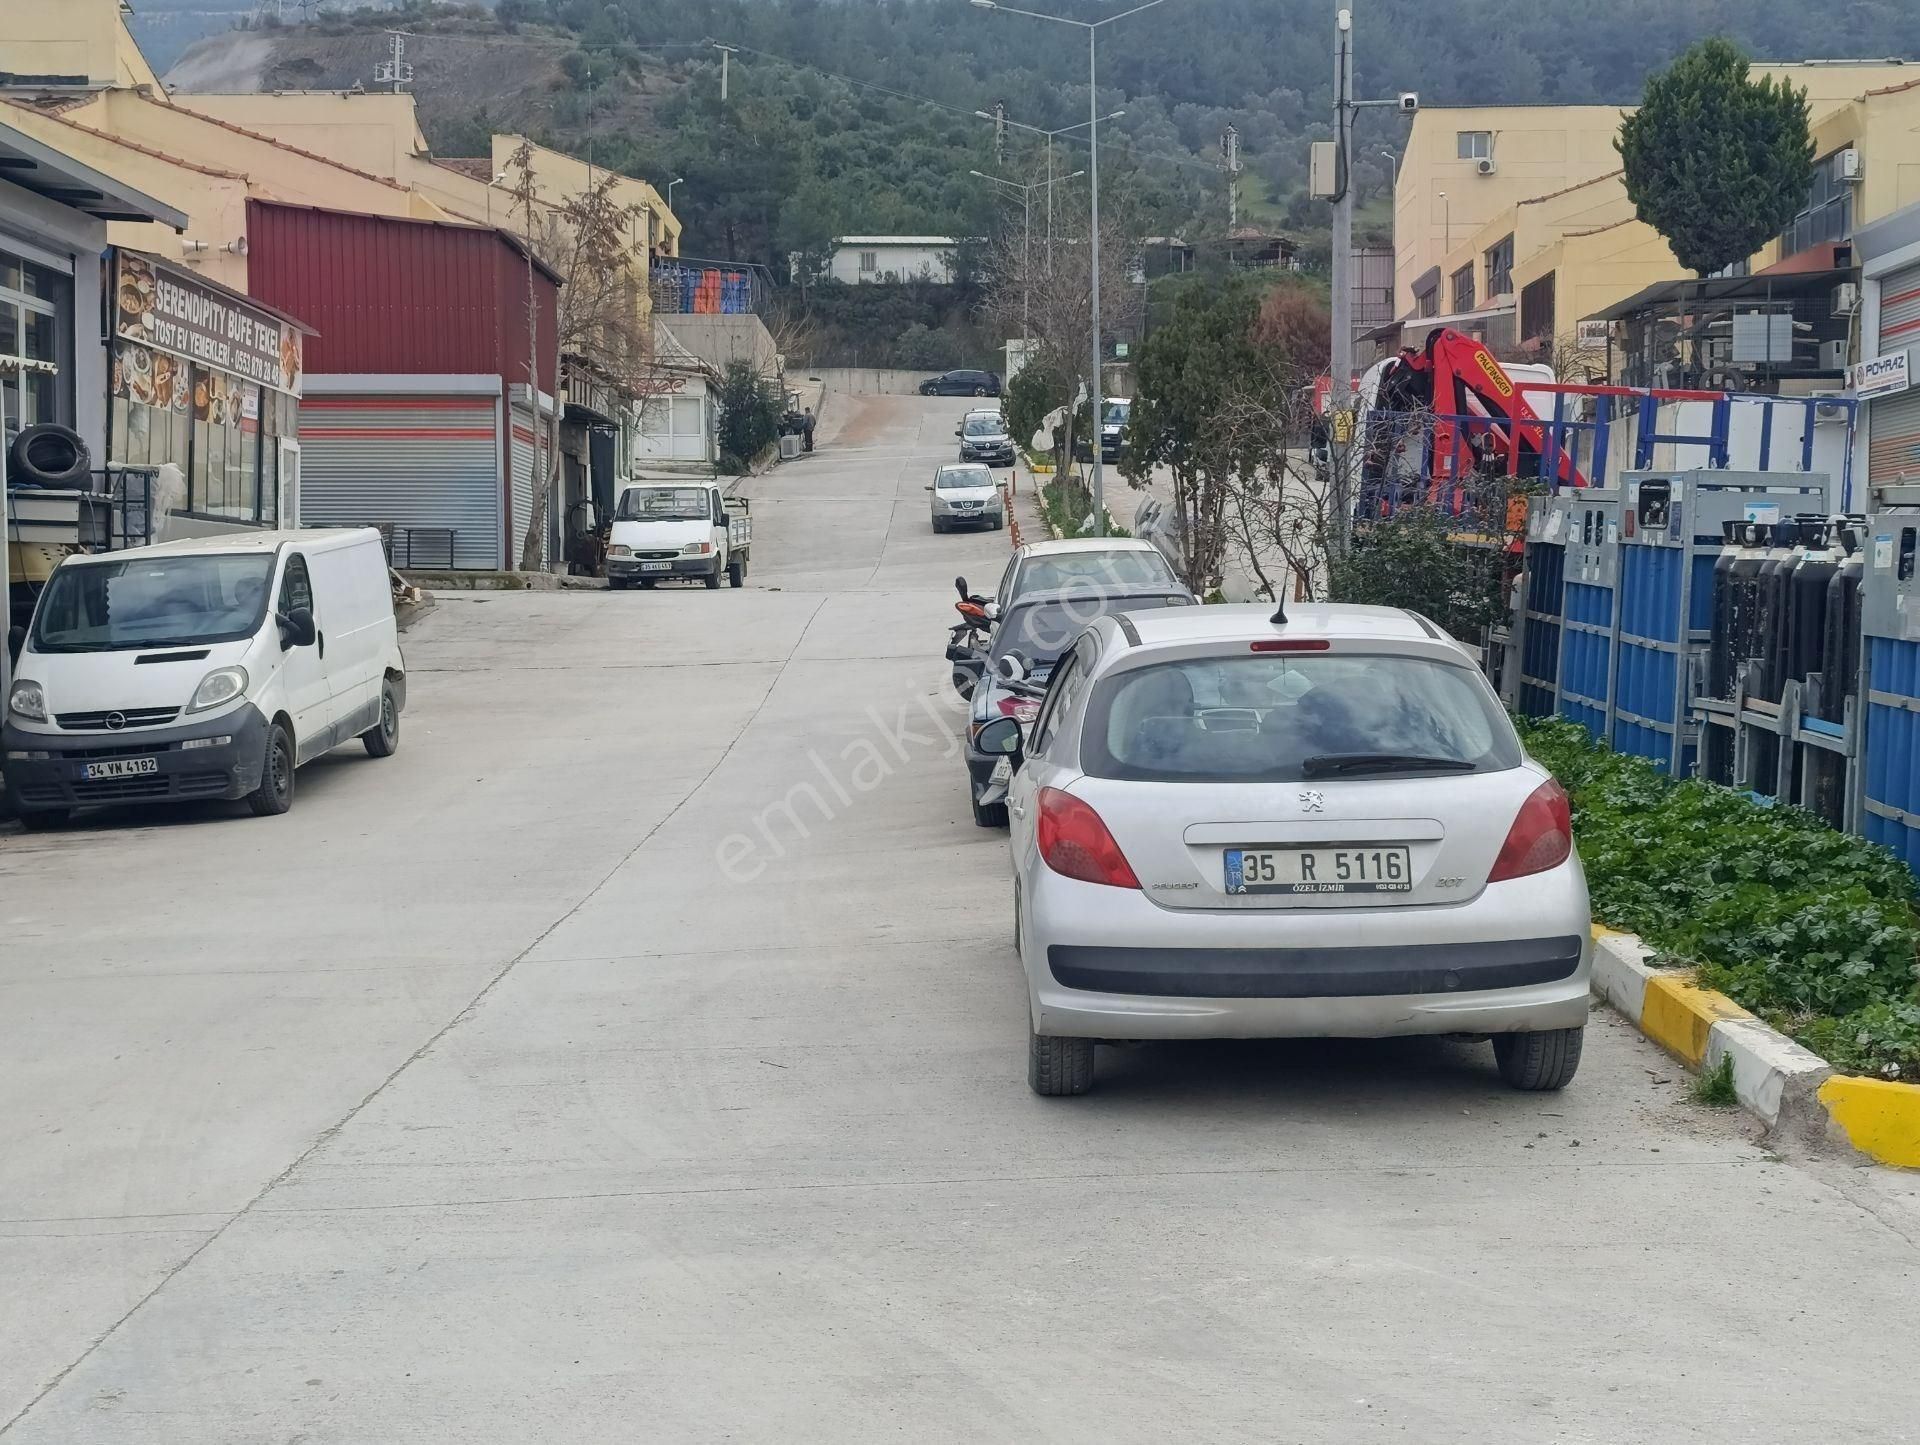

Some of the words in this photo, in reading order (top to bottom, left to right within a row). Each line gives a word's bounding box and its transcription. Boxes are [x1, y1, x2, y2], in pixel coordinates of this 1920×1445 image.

[156, 279, 226, 335] SERENDİPİTY
[228, 307, 252, 346] BÜFE
[254, 320, 280, 359] TEKEL
[155, 319, 176, 347] TOST
[177, 326, 188, 351] EV
[189, 330, 230, 367] YEMEKLERİ
[1476, 352, 1511, 395] PALFINGER
[1865, 355, 1905, 377] POYRAZ
[88, 764, 104, 777] 34
[107, 762, 123, 775] VN
[126, 759, 156, 773] 4182
[1243, 854, 1276, 882] 35
[1300, 853, 1316, 881] R
[1335, 852, 1402, 880] 5116
[1292, 882, 1317, 892] ÖZEL
[1318, 882, 1345, 892] İZMİR
